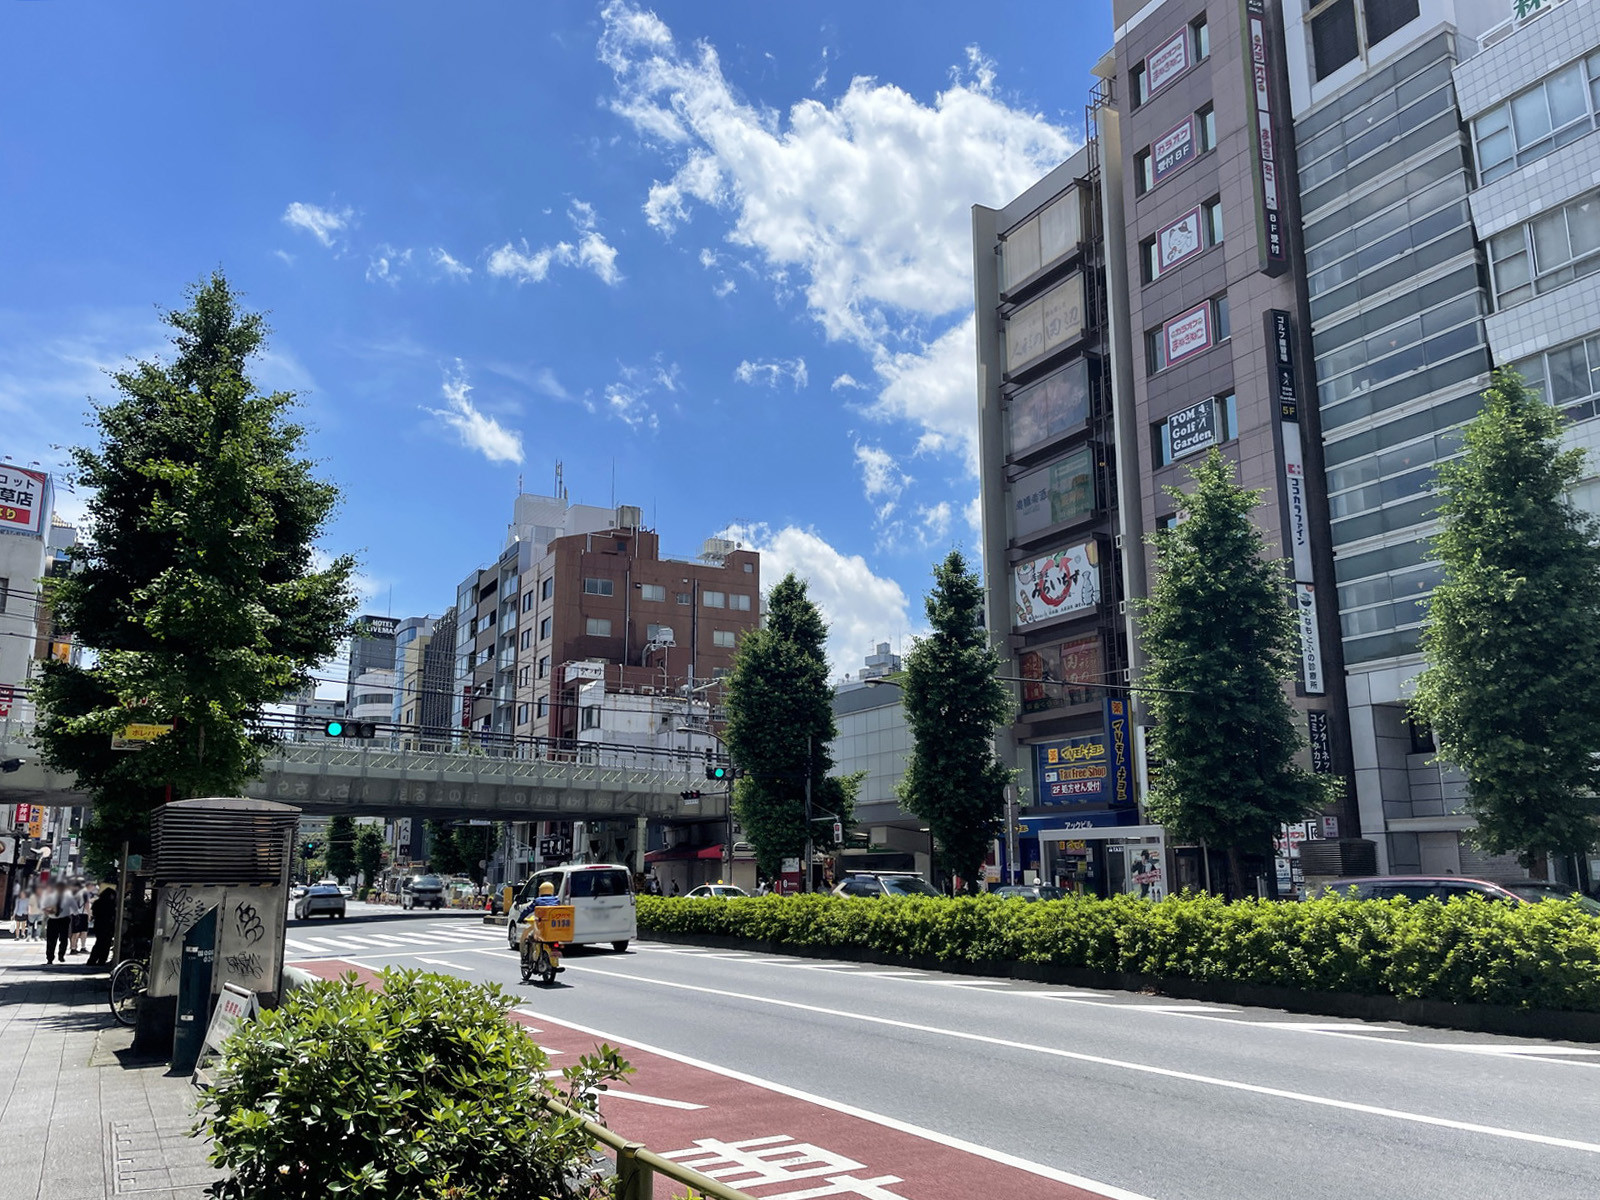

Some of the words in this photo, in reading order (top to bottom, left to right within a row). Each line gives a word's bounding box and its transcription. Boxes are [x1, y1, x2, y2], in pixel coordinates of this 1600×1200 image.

[1157, 128, 1188, 155] カラオケ
[1171, 328, 1204, 352] まねきねこ
[1170, 408, 1195, 426] TOM
[1282, 406, 1295, 415] 5F
[1172, 421, 1196, 438] Golf
[1173, 429, 1214, 451] Garden
[1292, 477, 1304, 546] ココカラファイン
[372, 620, 394, 628] HOTEL
[1061, 743, 1105, 761] マツモトキヨシ
[1310, 714, 1322, 773] コミックカフ
[1318, 714, 1330, 772] インターネッ
[1112, 719, 1127, 800] マツモトキヨシ
[1059, 769, 1072, 781] Tax
[1072, 767, 1087, 779] Free
[1088, 765, 1107, 778] Shop
[1052, 786, 1060, 794] 2F
[1061, 781, 1100, 794] 処方せん受付
[1064, 821, 1093, 831] アックビル
